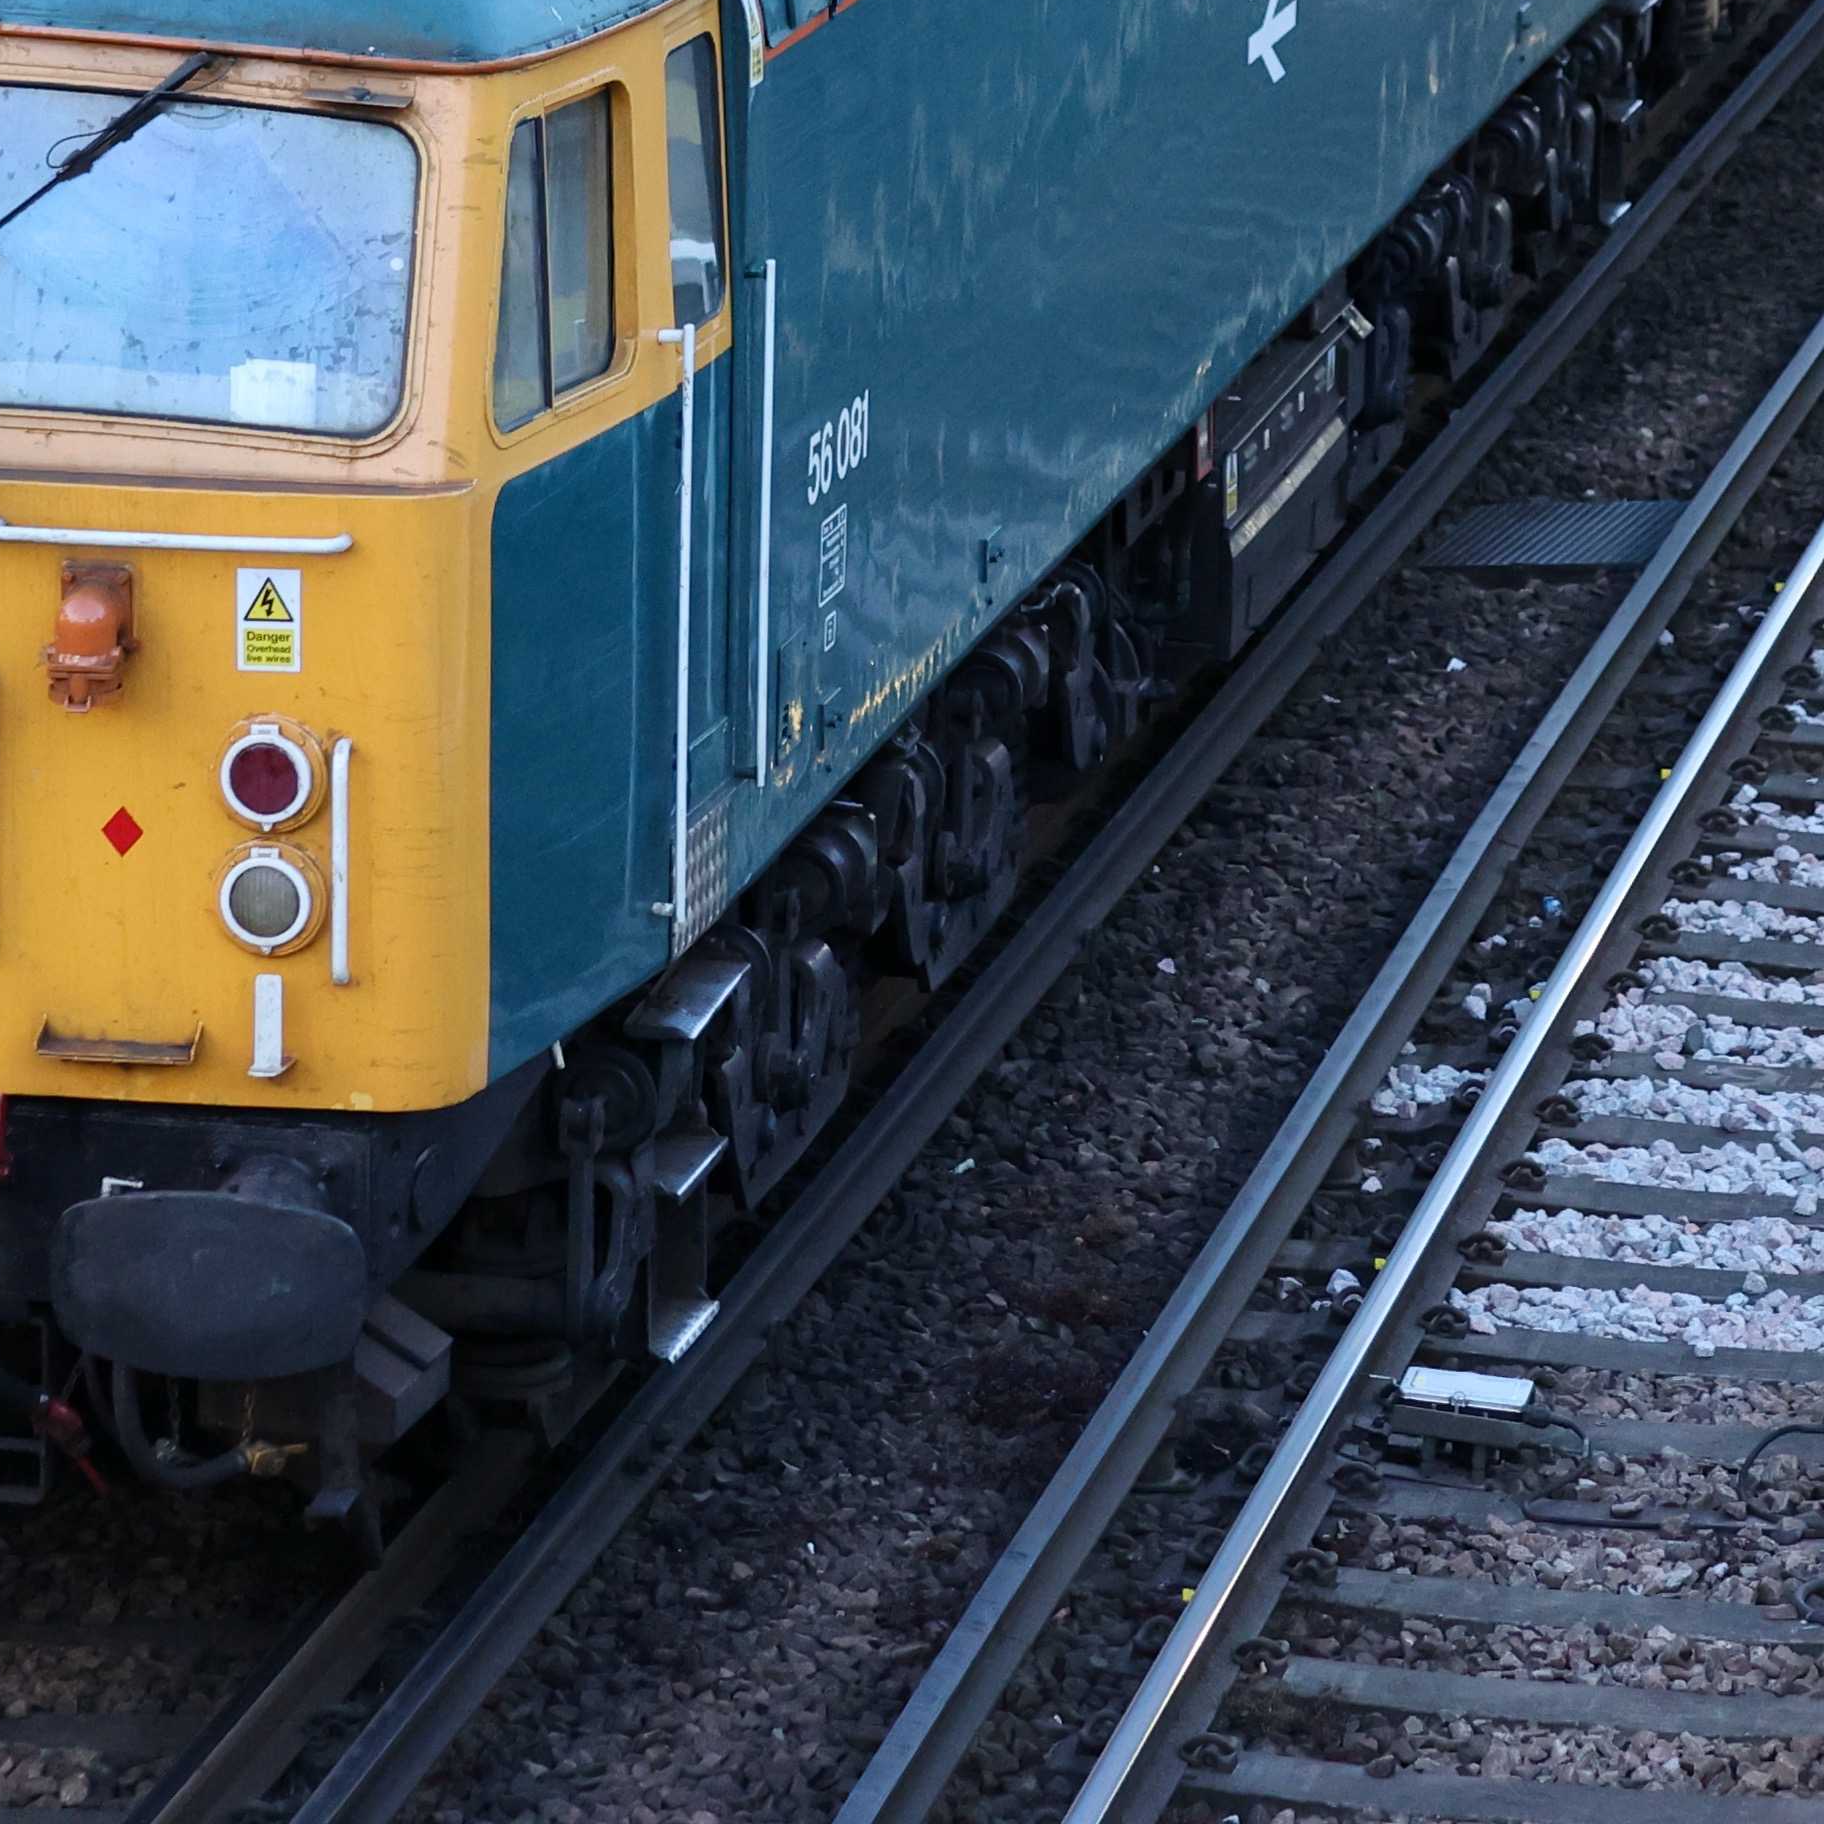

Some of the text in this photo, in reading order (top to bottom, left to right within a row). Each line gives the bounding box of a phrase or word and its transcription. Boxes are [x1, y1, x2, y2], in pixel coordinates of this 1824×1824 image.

[807, 388, 870, 506] 56 081
[246, 630, 292, 644] Danger
[246, 644, 292, 654] Overhead
